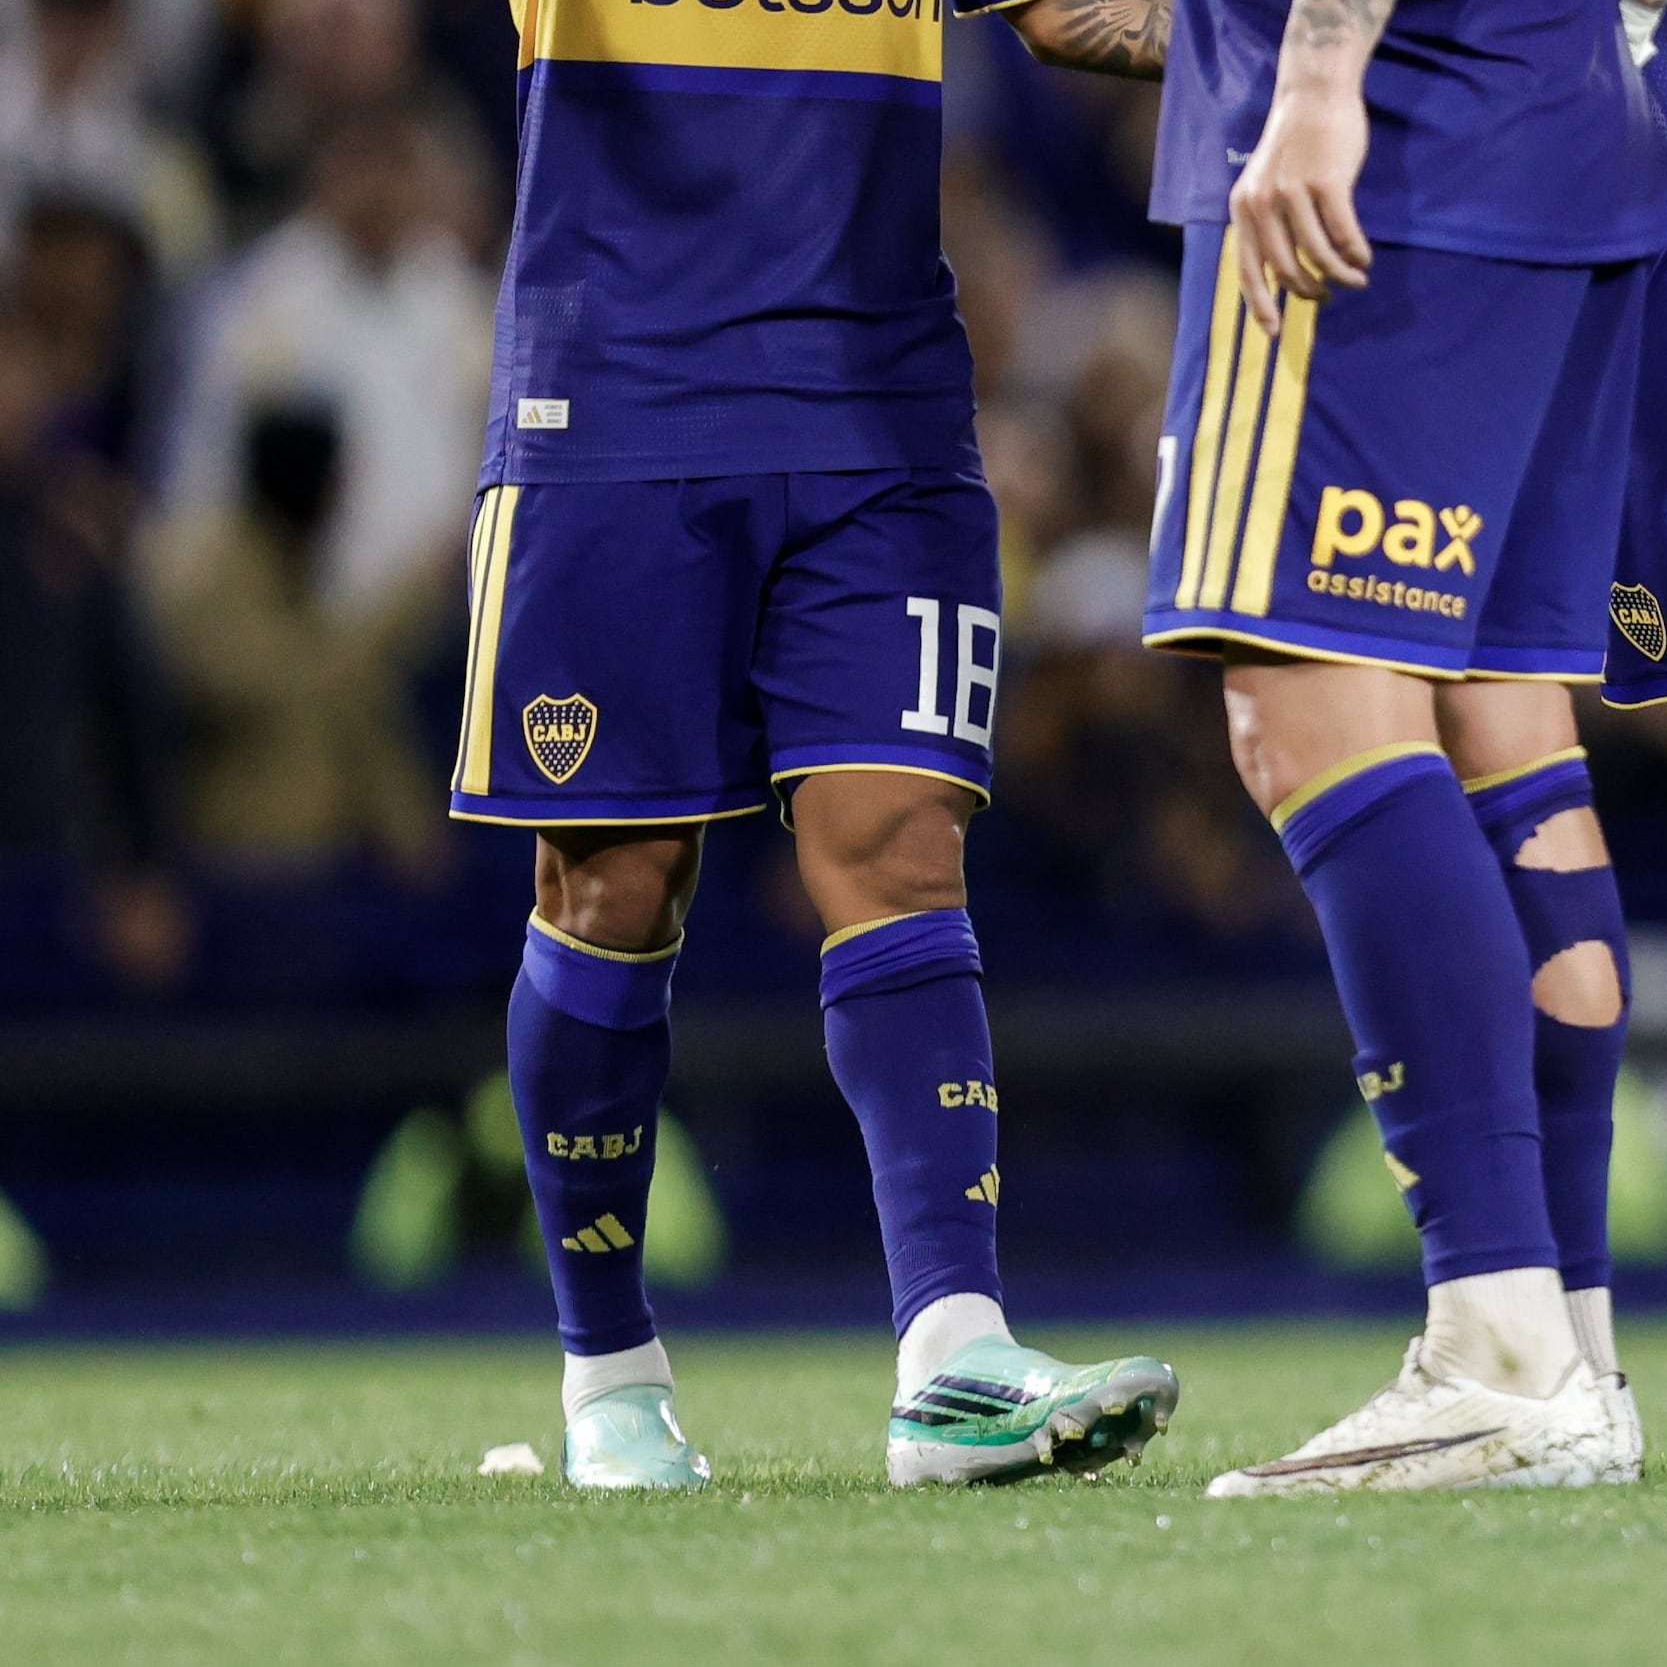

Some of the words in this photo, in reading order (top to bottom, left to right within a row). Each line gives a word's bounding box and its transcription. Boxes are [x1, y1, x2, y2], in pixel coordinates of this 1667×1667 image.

[1310, 485, 1484, 577] pax
[1307, 569, 1468, 621] assistance
[1618, 608, 1660, 626] CABJ
[901, 596, 1000, 749] 18
[533, 724, 587, 742] CABJ
[938, 1079, 999, 1116] CAB
[546, 1124, 643, 1160] CABJ
